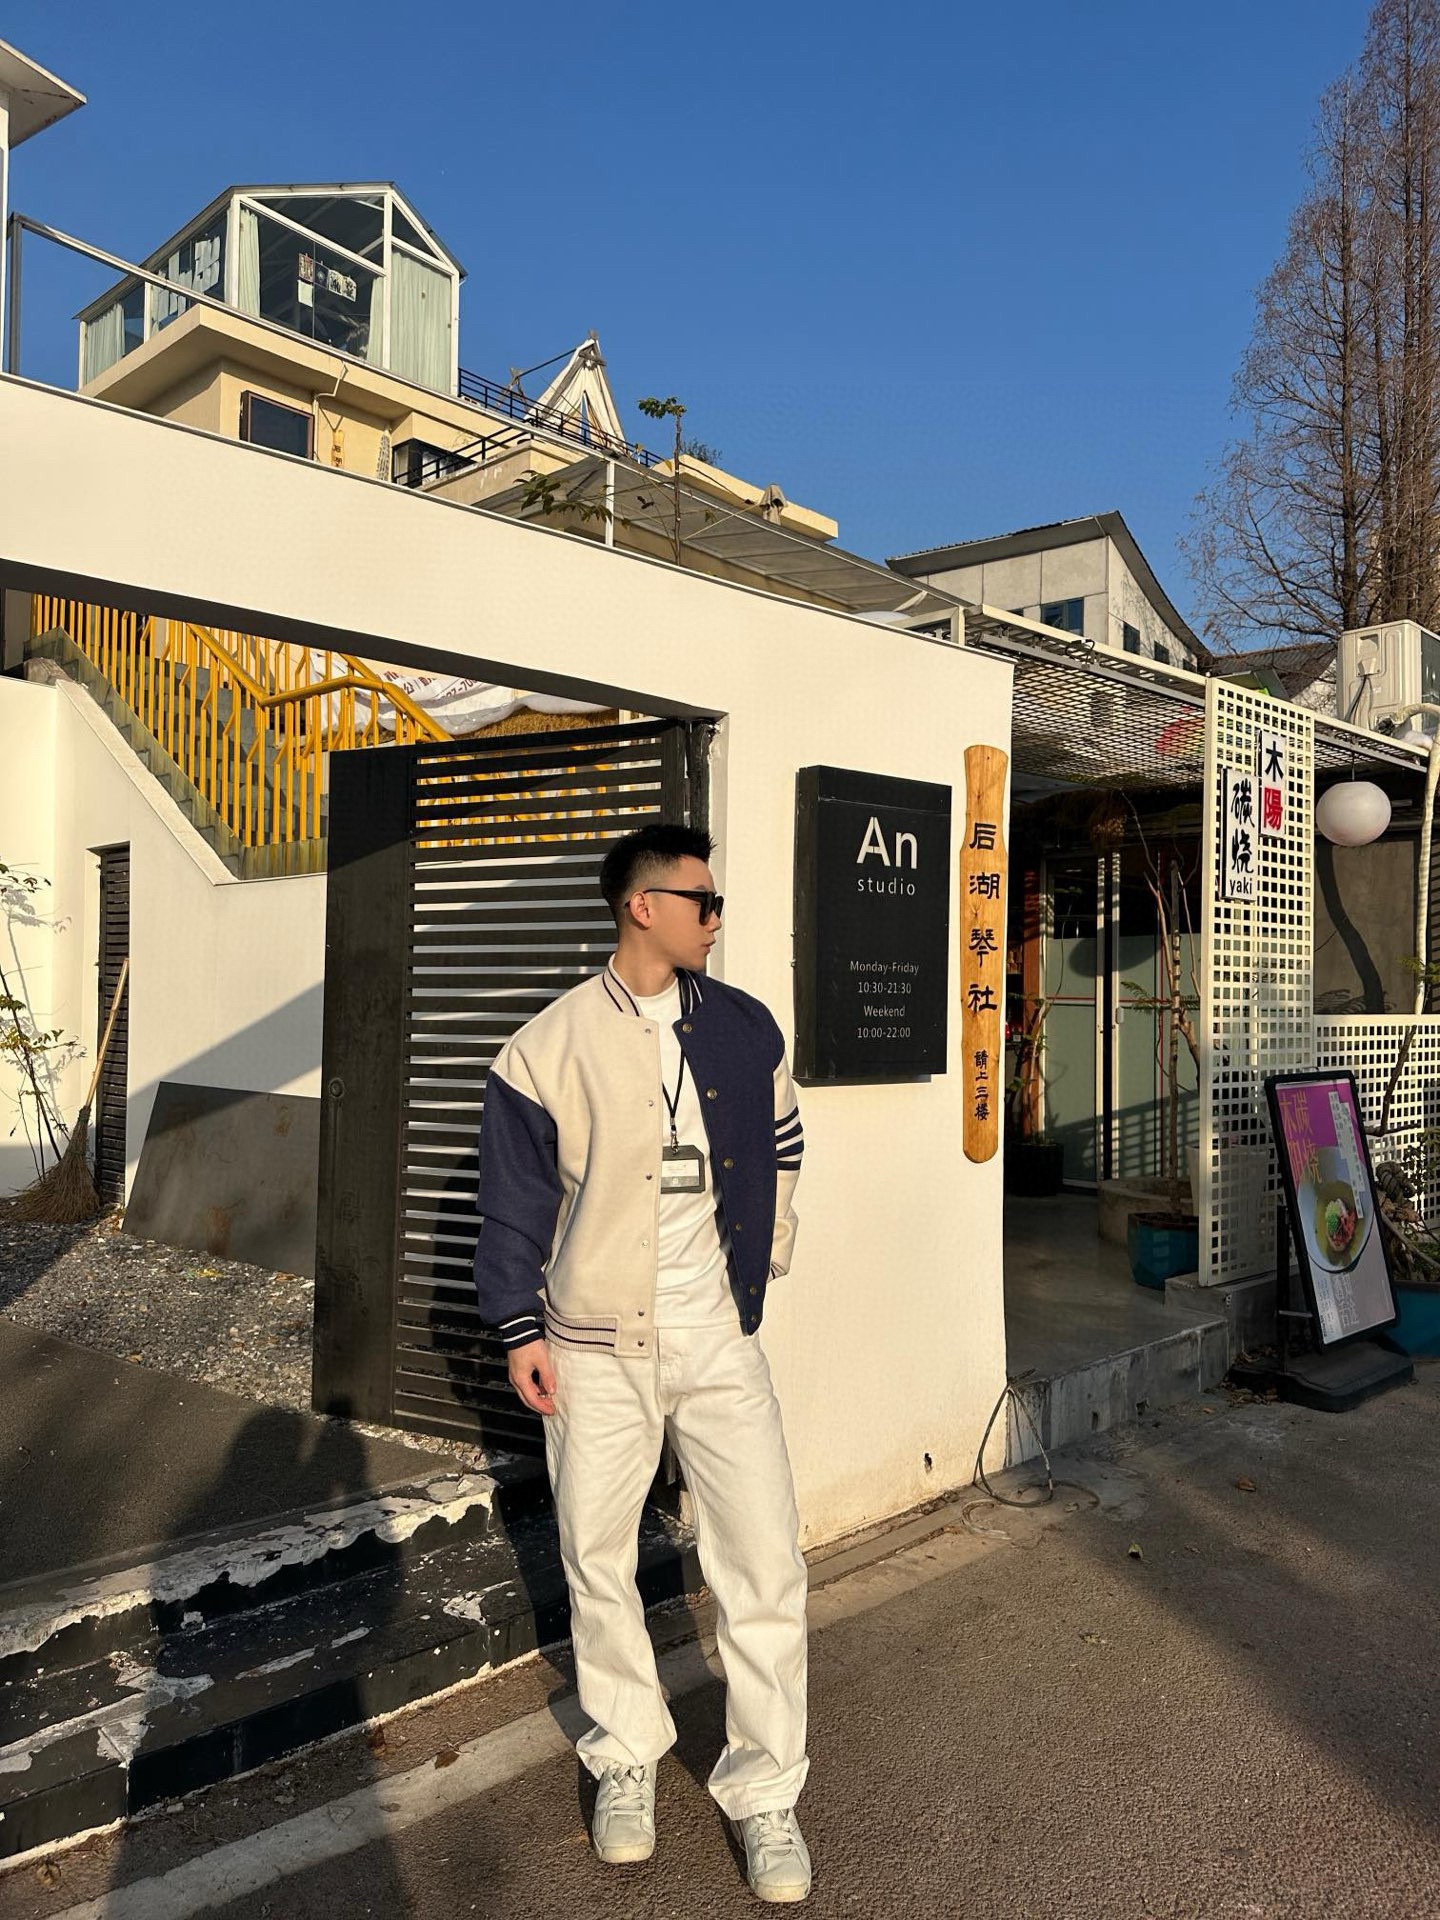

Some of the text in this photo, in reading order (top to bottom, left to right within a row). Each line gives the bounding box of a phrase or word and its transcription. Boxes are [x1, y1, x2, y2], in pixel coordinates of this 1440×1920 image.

[1264, 740, 1285, 832] 木陽
[856, 816, 918, 870] An
[857, 877, 916, 896] studio
[1229, 877, 1253, 896] yaki
[968, 822, 1001, 1013] 后湖琴社
[850, 960, 920, 976] Monday-Friday
[857, 981, 912, 995] 10:30-21:30
[863, 1004, 906, 1018] Weekend
[857, 1026, 911, 1039] 10:00-22:00
